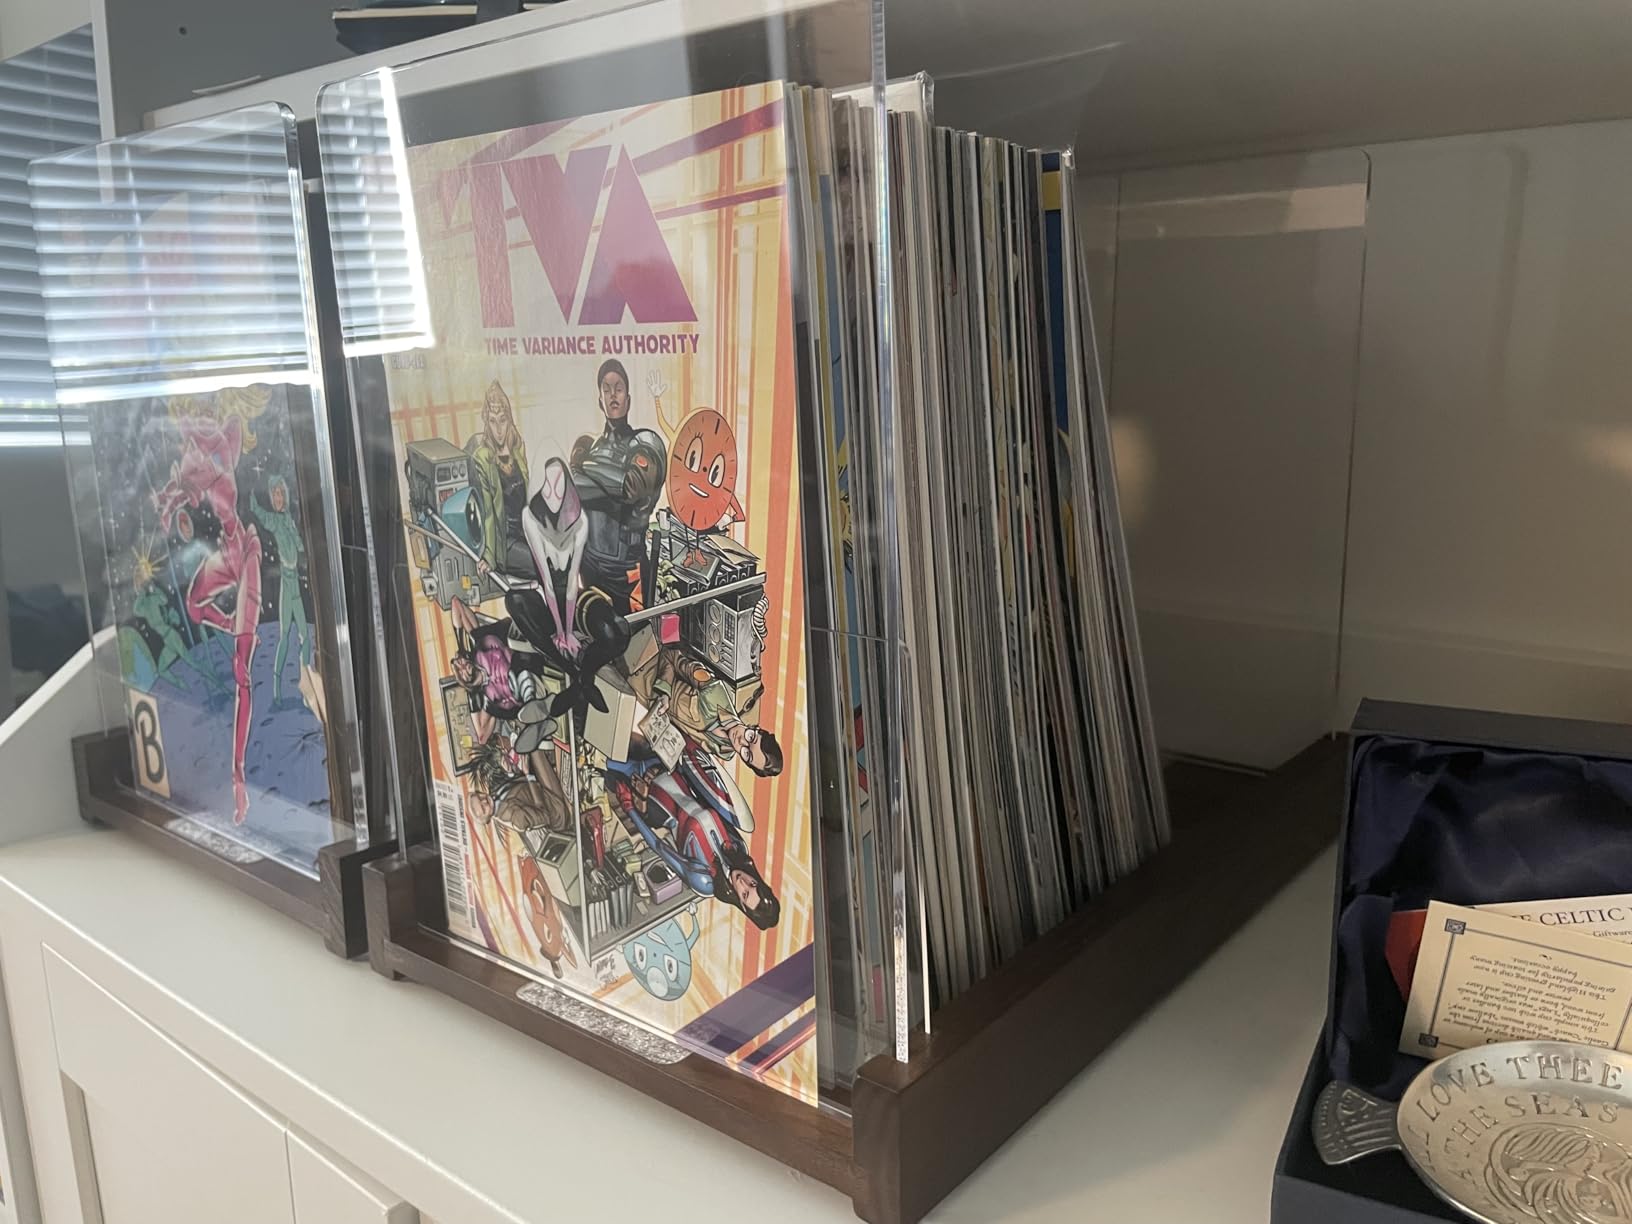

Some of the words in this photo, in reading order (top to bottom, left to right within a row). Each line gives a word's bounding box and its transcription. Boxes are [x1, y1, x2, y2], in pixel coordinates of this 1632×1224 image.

[485, 336, 518, 355] TIME
[522, 335, 596, 355] VARIANCE
[601, 332, 700, 354] AUTHORITY
[1539, 907, 1625, 926] CELTIC
[1416, 1062, 1495, 1121] LOVE
[1506, 1055, 1624, 1090] THEE
[1504, 1094, 1619, 1123] SEAS
